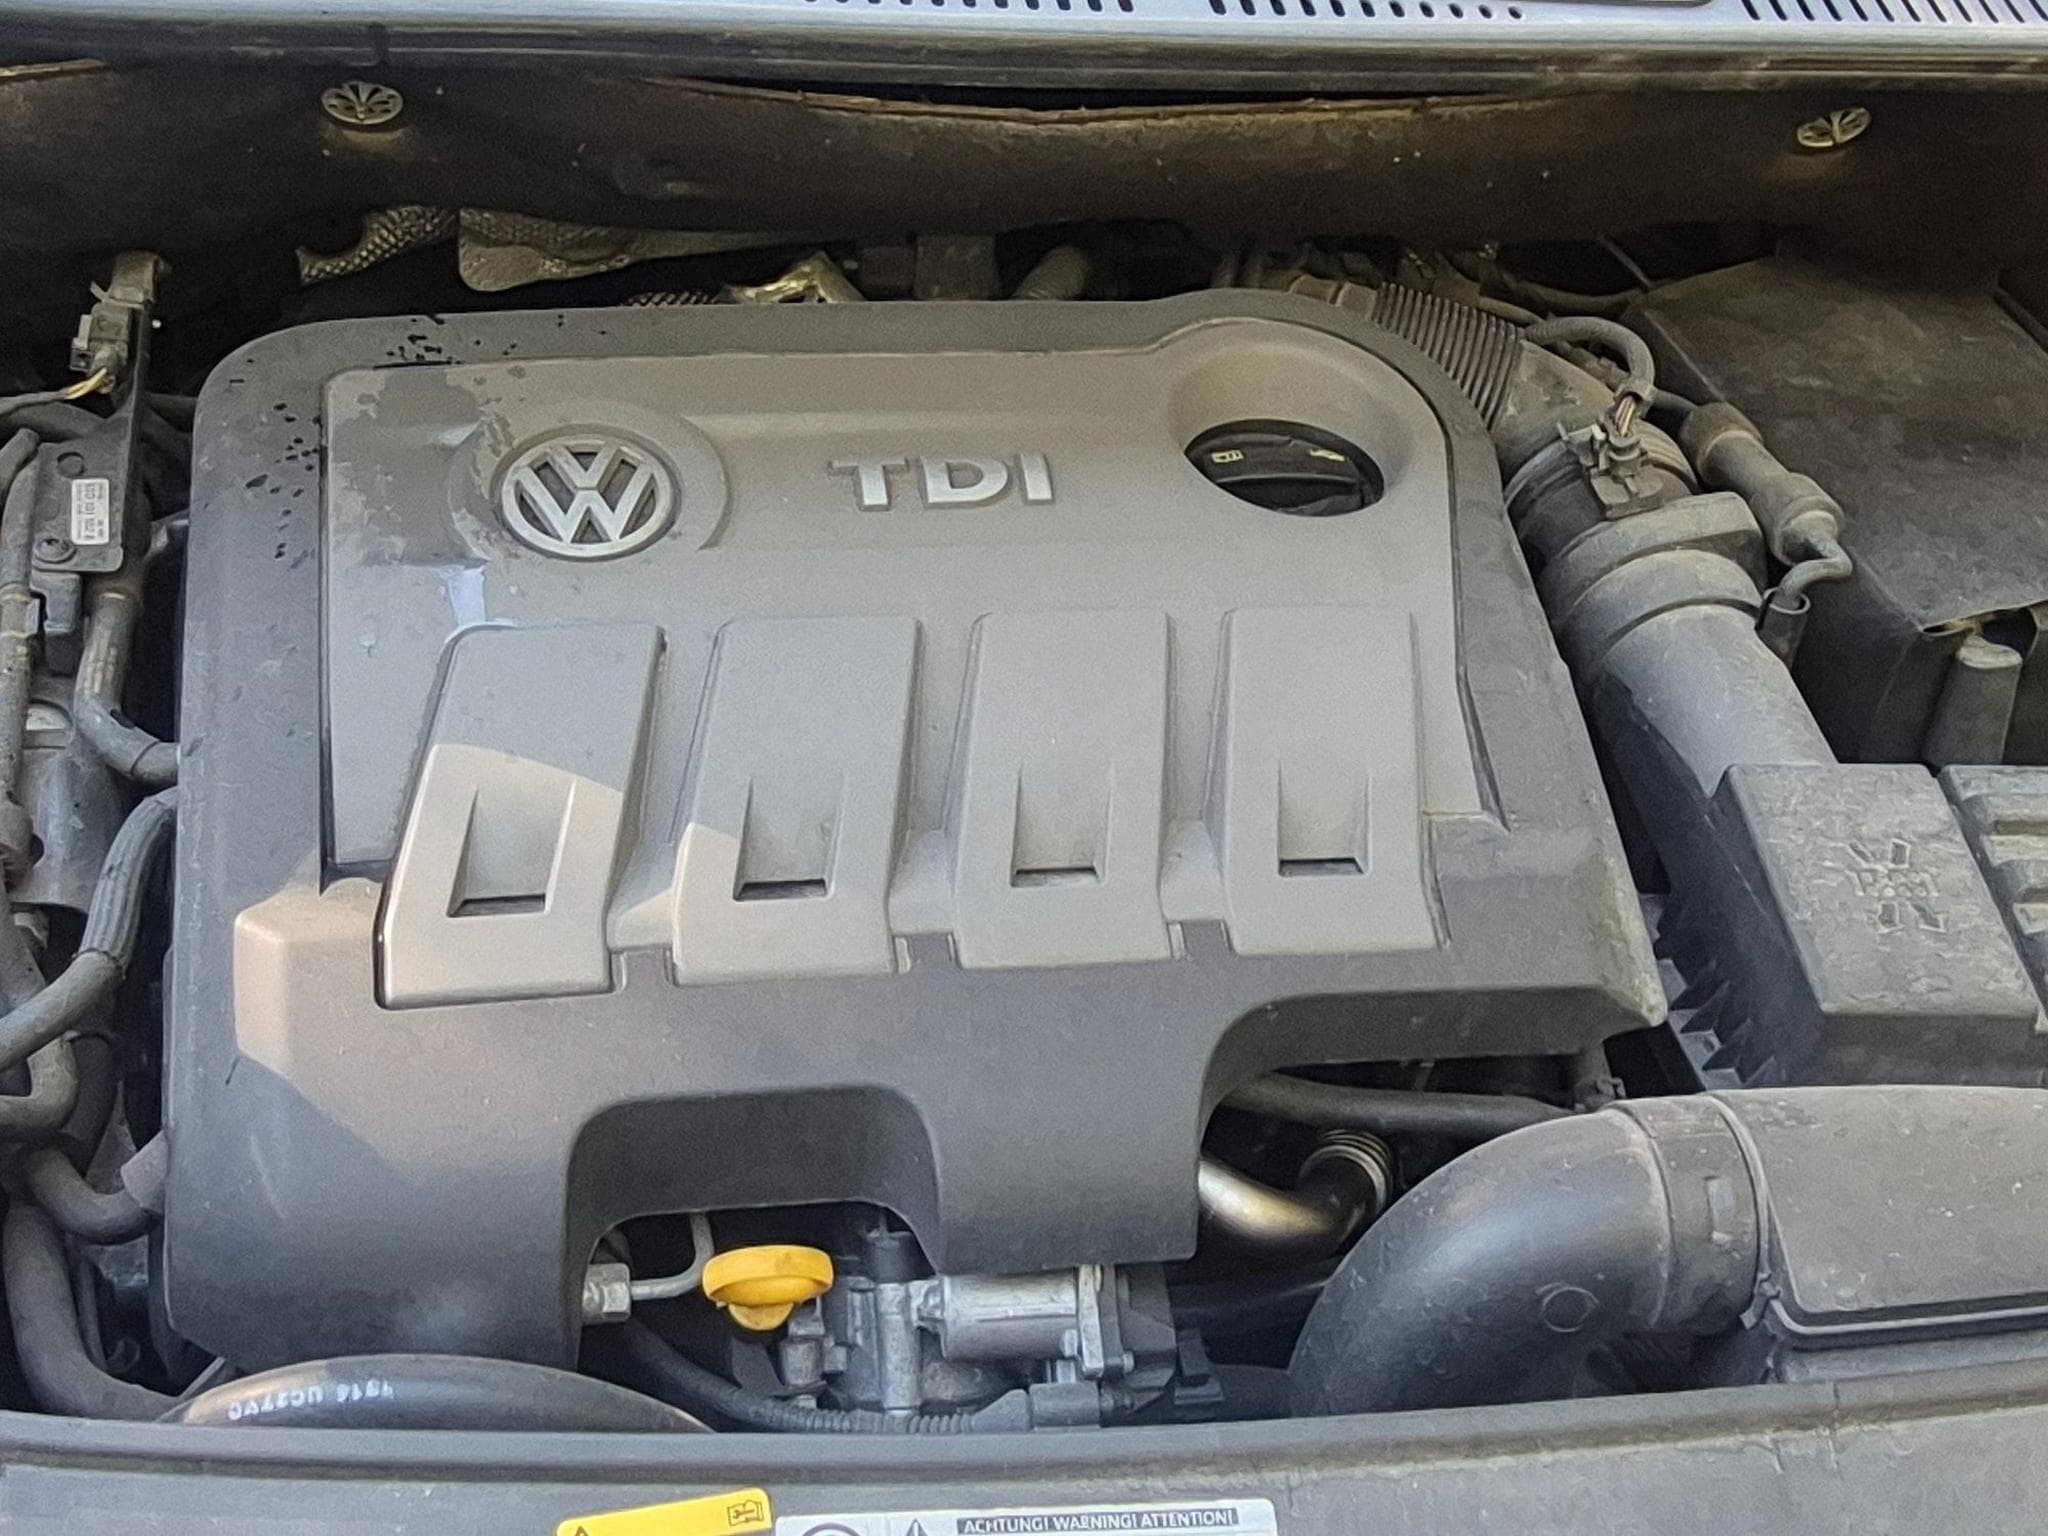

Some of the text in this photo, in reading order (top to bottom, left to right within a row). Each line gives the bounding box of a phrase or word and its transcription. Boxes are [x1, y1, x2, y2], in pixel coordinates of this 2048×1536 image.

[501, 434, 673, 557] VW
[830, 452, 1053, 508] TDI
[963, 1508, 1233, 1534] ACHTUNG! WARNING! ATTENTION!
